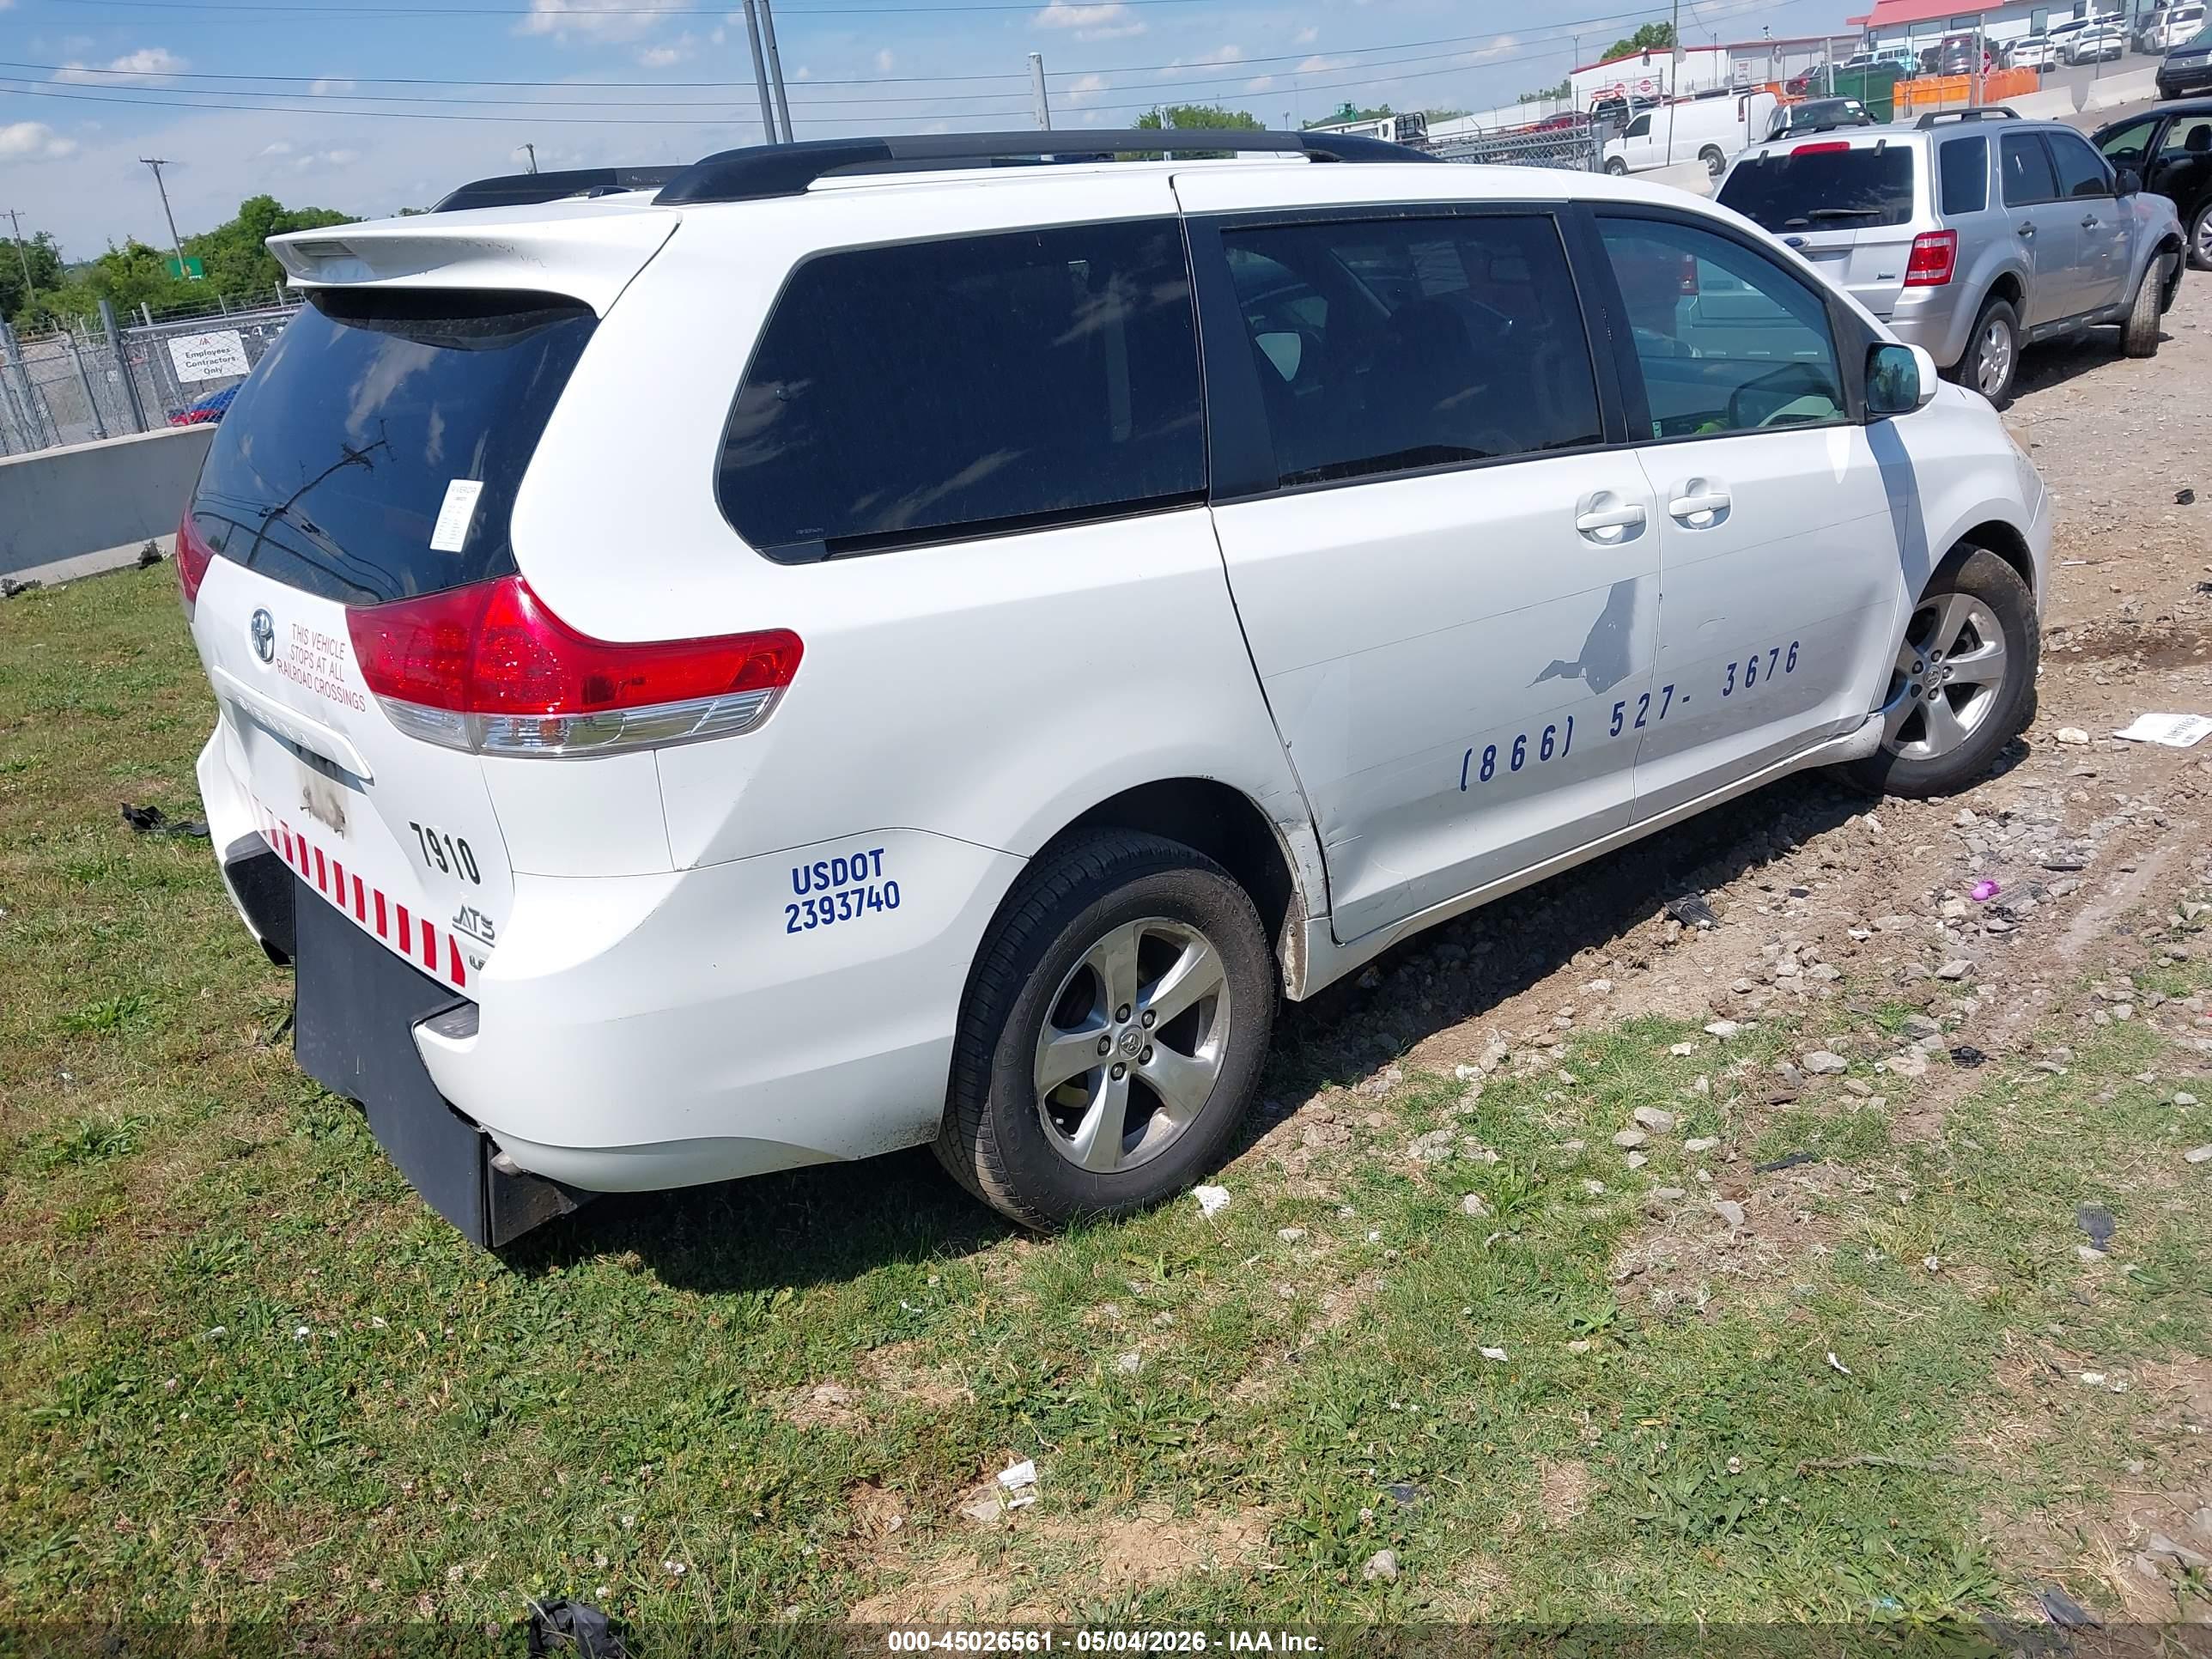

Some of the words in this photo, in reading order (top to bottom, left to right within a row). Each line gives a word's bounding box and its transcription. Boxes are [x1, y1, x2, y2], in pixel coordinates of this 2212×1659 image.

[185, 347, 231, 359] Employees
[185, 356, 236, 368] Contractors
[204, 366, 223, 375] Only
[291, 623, 309, 646] THIS
[312, 632, 346, 660] VEHICLE
[290, 644, 314, 669] STOPS
[316, 655, 327, 675] AT
[329, 662, 344, 683] ALL
[1723, 640, 1800, 697] 3676
[276, 658, 312, 690] RAILROAD
[314, 677, 366, 713] CROSSINGS
[409, 821, 481, 885] 7910
[792, 848, 884, 895] USDOT
[785, 880, 901, 934] 2393740
